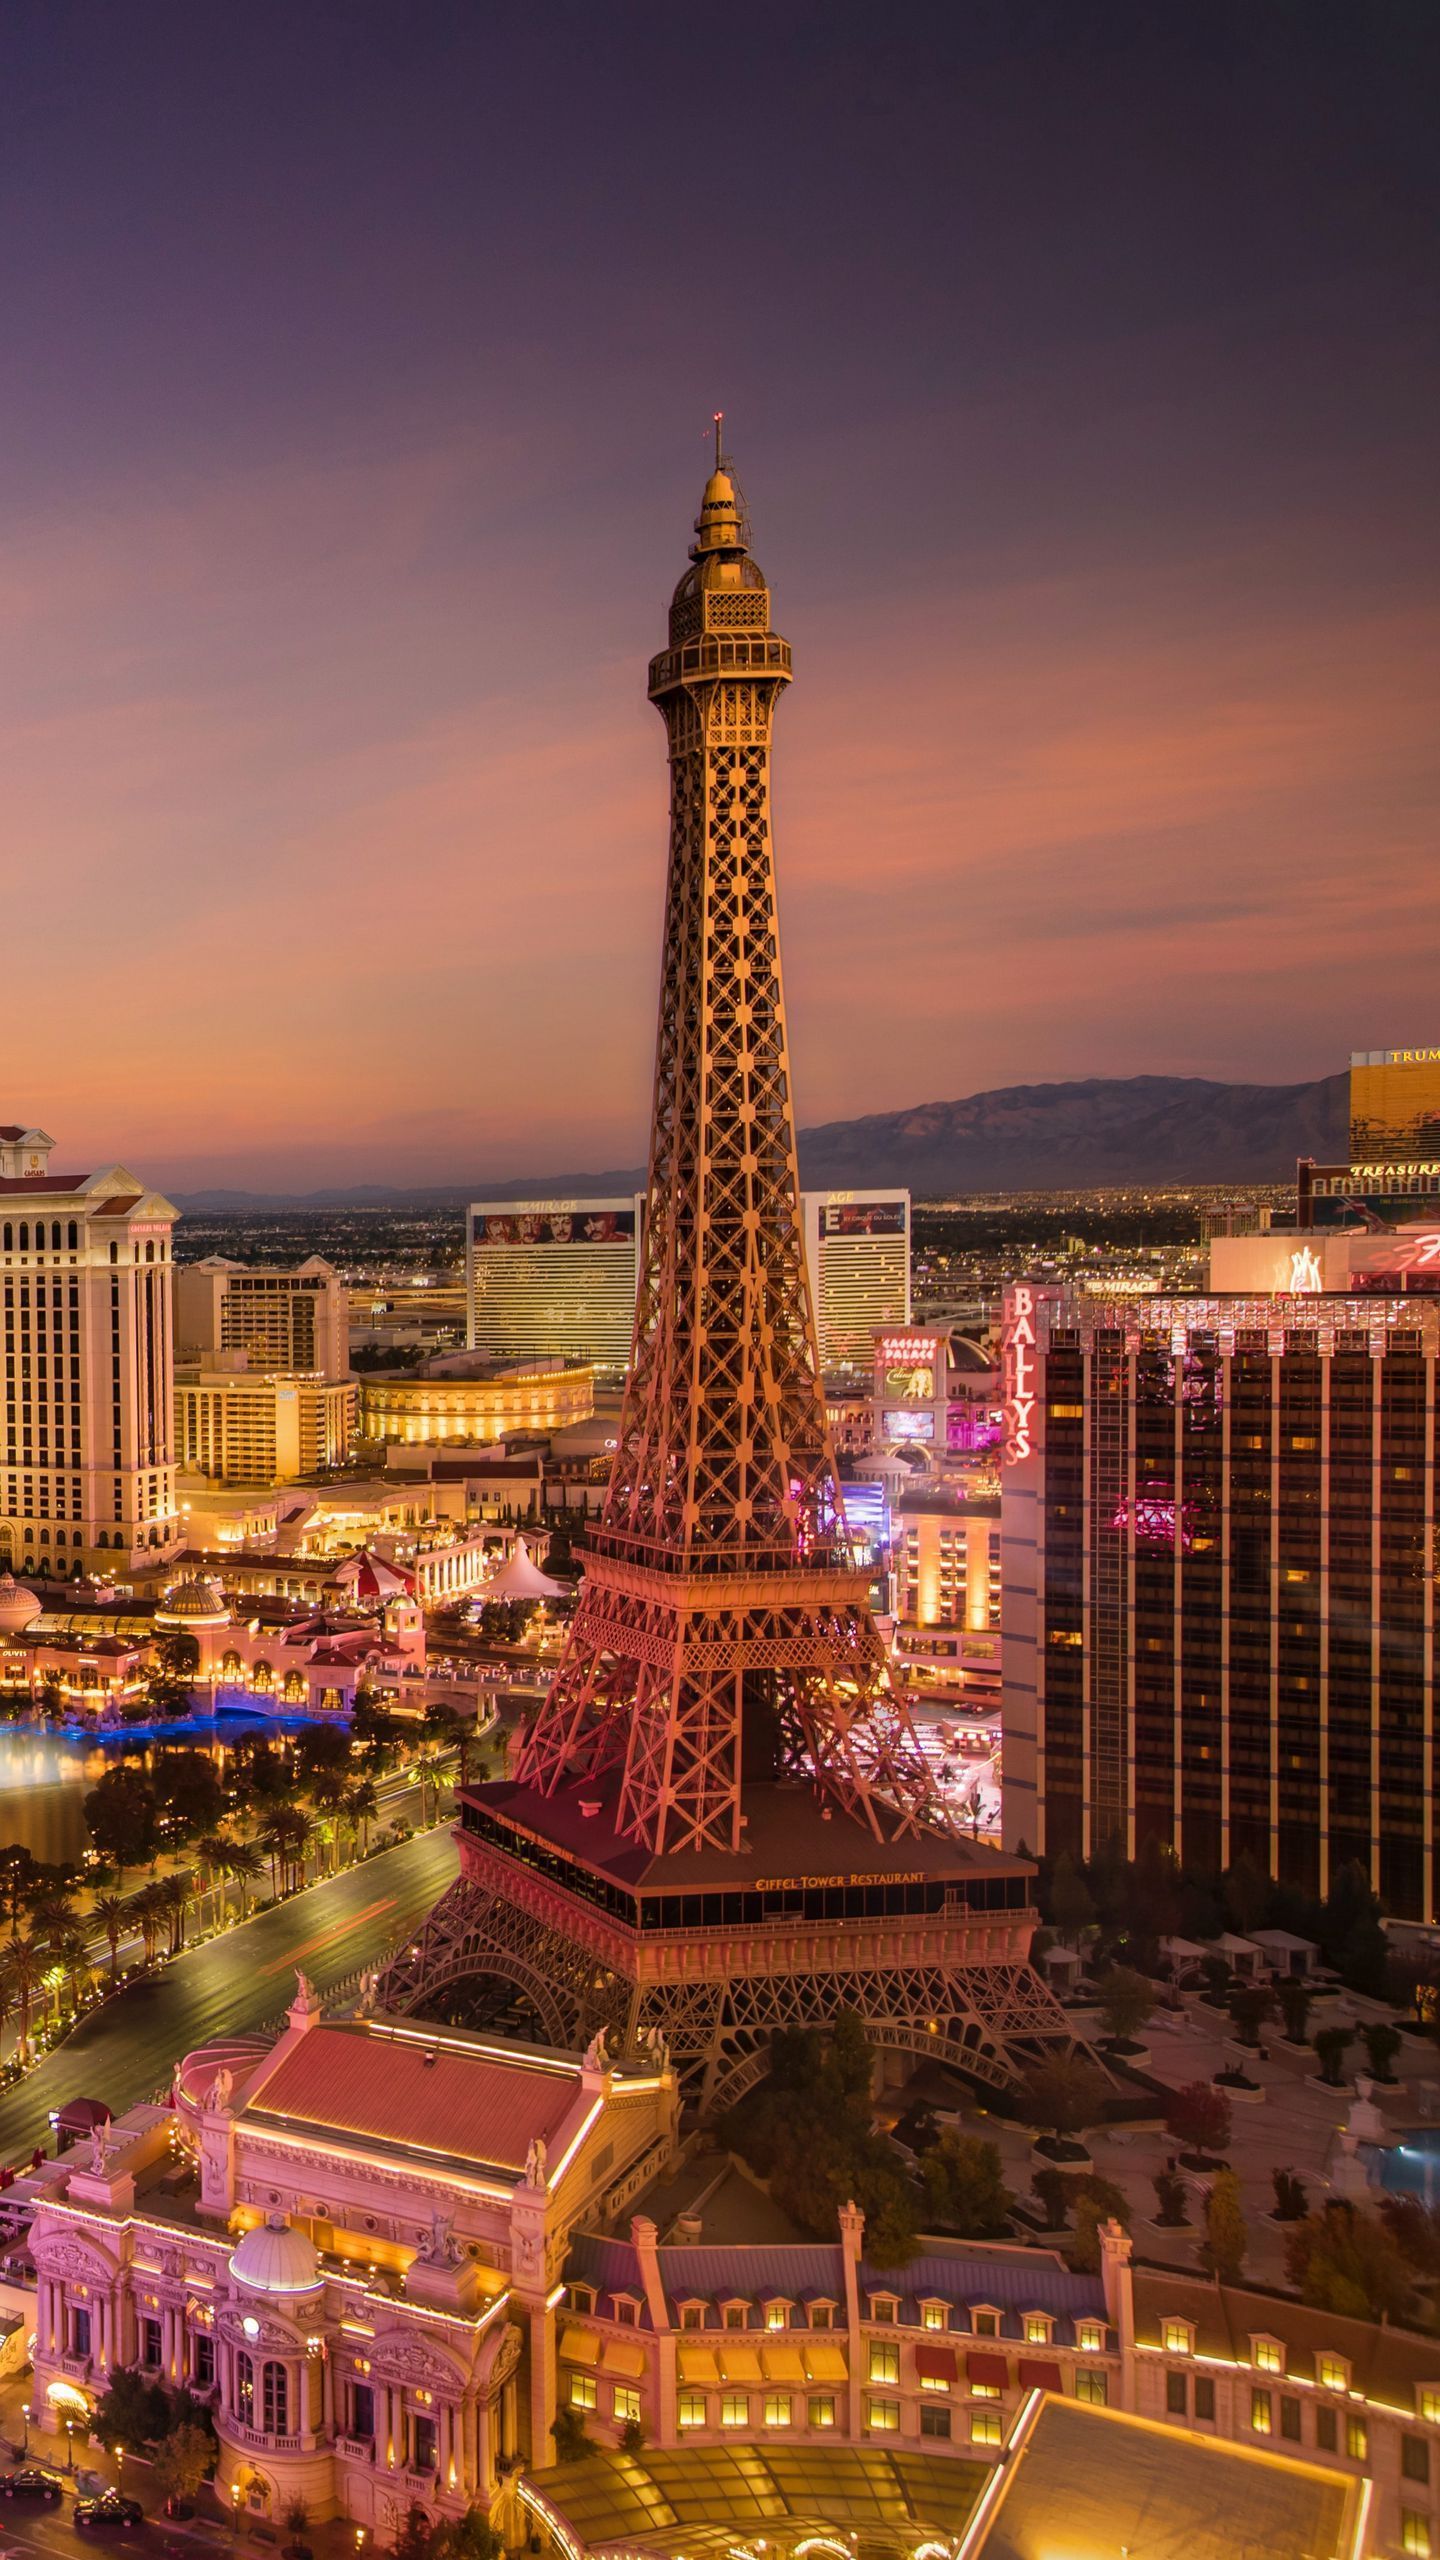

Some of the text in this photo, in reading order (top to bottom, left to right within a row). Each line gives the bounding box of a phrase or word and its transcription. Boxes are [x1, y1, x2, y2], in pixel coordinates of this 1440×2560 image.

[1350, 1164, 1440, 1177] TREASURE
[526, 1200, 578, 1212] MIRAGE
[1103, 1281, 1158, 1293] MIRAGE
[882, 1338, 937, 1349] CAESARS
[885, 1349, 934, 1360] PALACE
[755, 1871, 925, 1891] EIFFEL TOWER RESTAURANT
